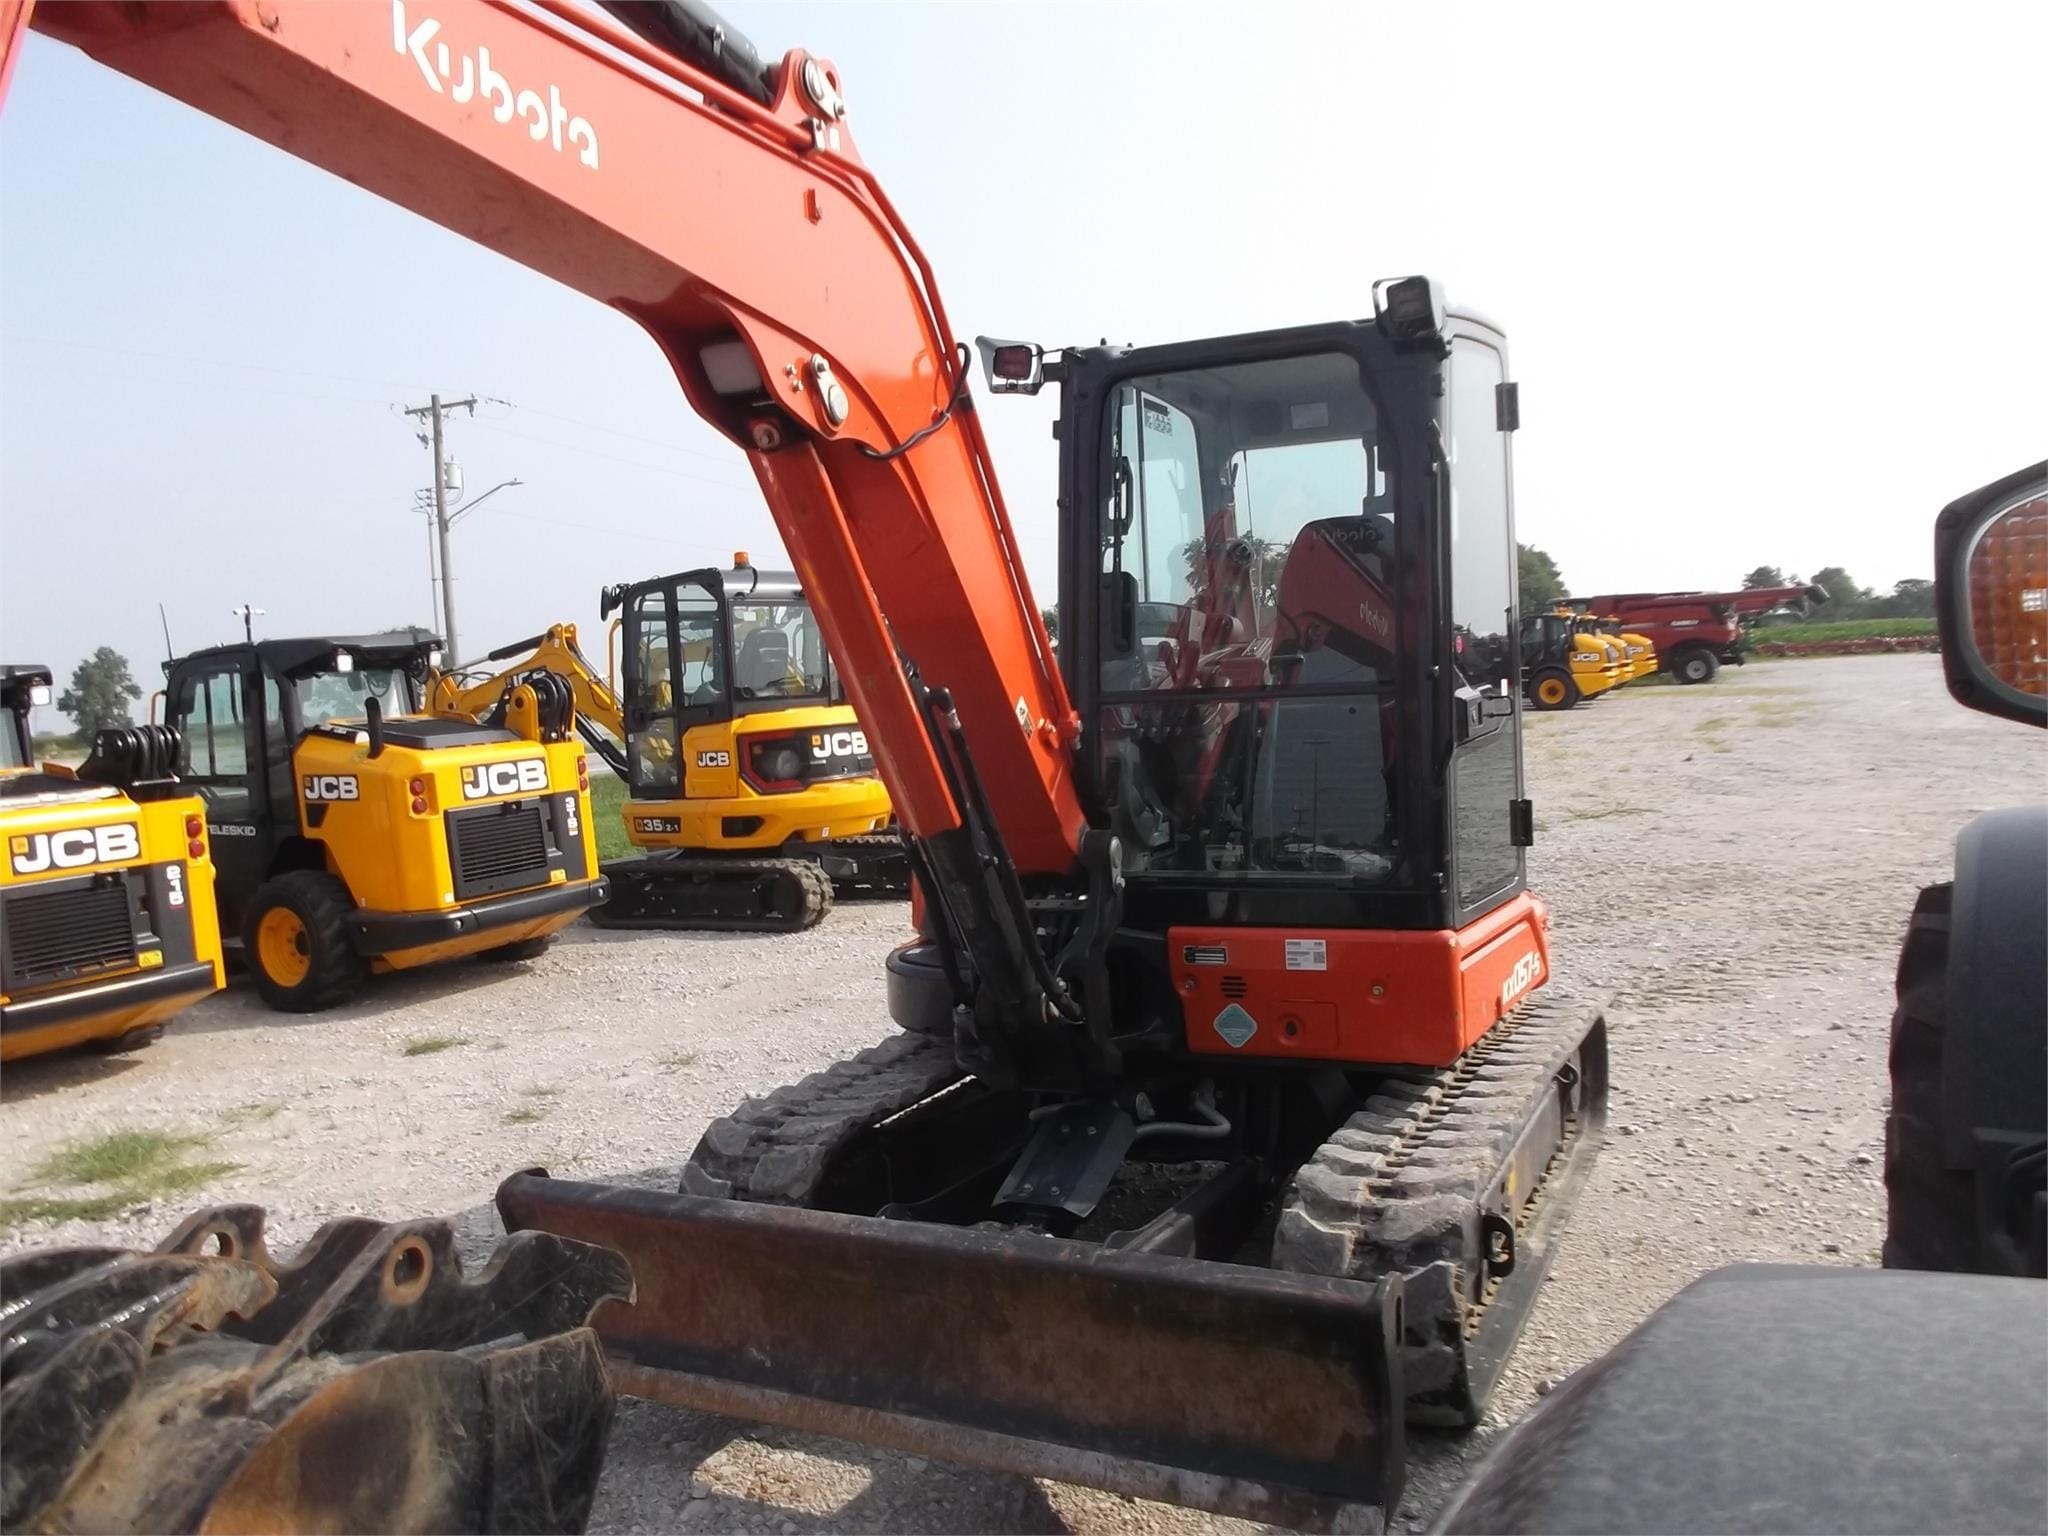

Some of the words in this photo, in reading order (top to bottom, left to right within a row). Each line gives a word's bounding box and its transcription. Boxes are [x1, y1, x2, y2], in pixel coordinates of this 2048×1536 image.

[392, 0, 599, 170] Kubota
[698, 752, 730, 768] JCB
[812, 731, 868, 758] JCB
[304, 775, 359, 800] JCB
[462, 758, 548, 798] JCB
[12, 823, 140, 873] JCB
